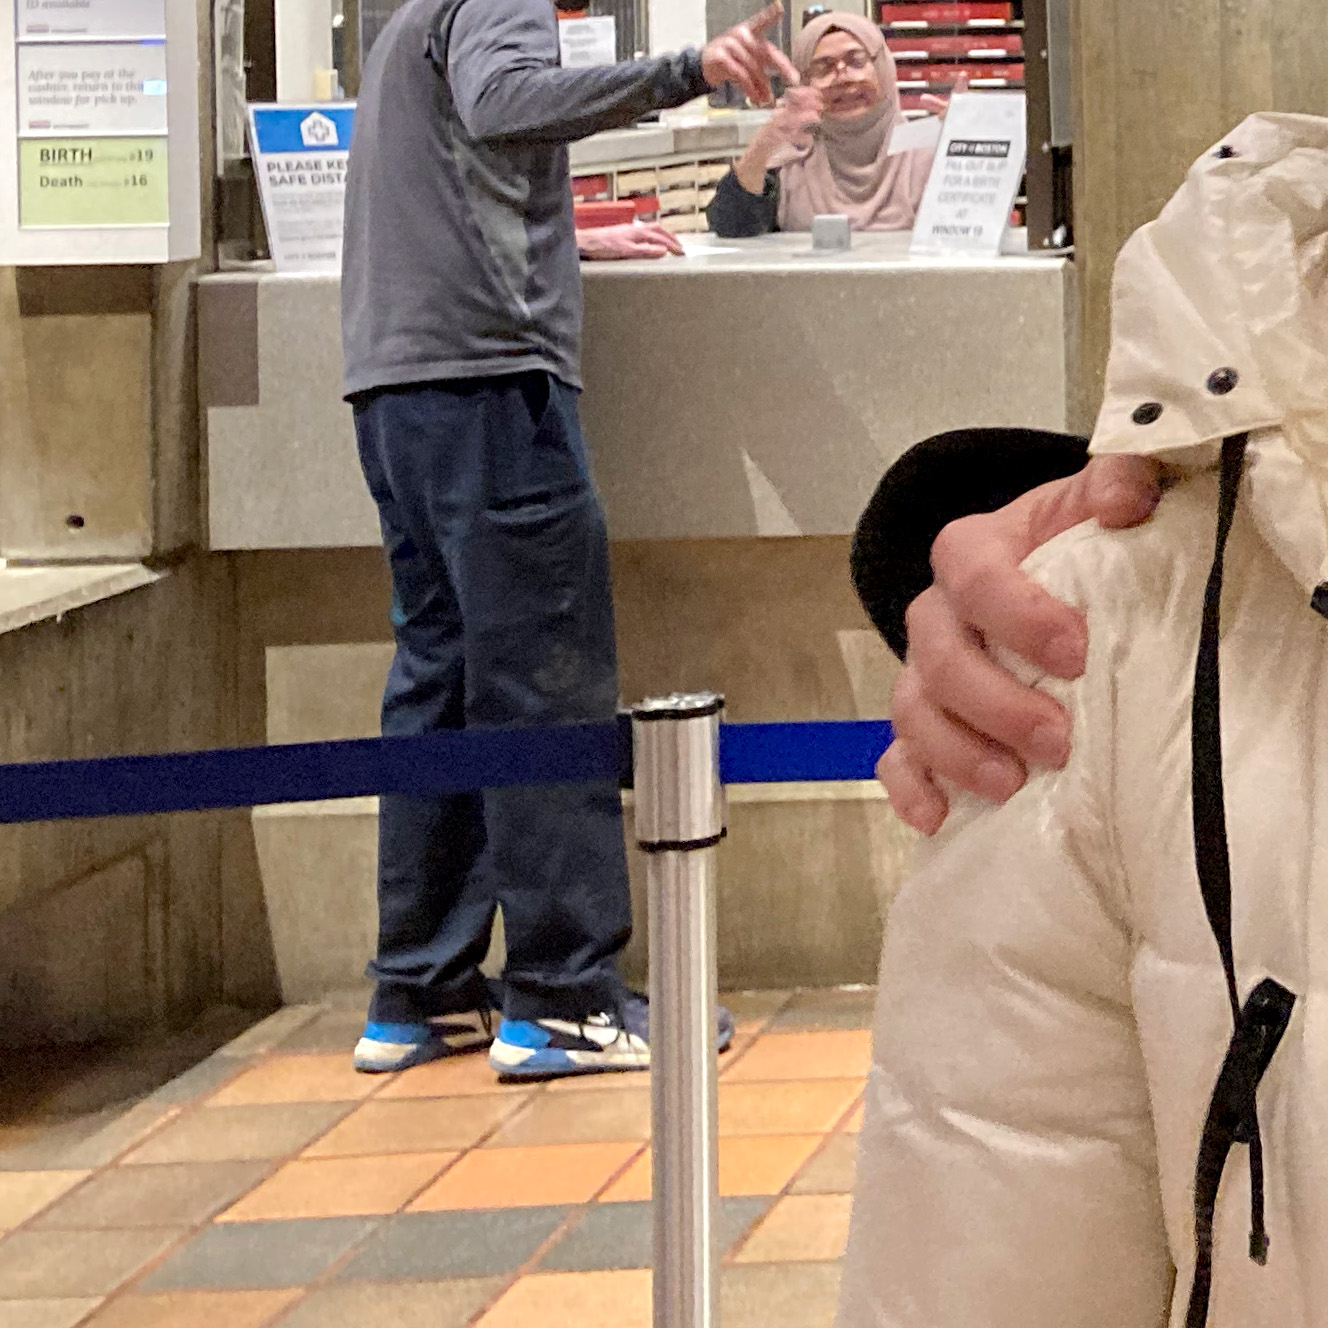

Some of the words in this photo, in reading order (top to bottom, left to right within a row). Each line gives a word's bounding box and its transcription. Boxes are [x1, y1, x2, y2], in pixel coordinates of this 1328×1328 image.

[39, 147, 93, 163] BIRTH
[267, 158, 323, 172] PLEASE
[327, 158, 349, 172] KE
[39, 175, 84, 189] Death
[269, 173, 307, 187] SAFE
